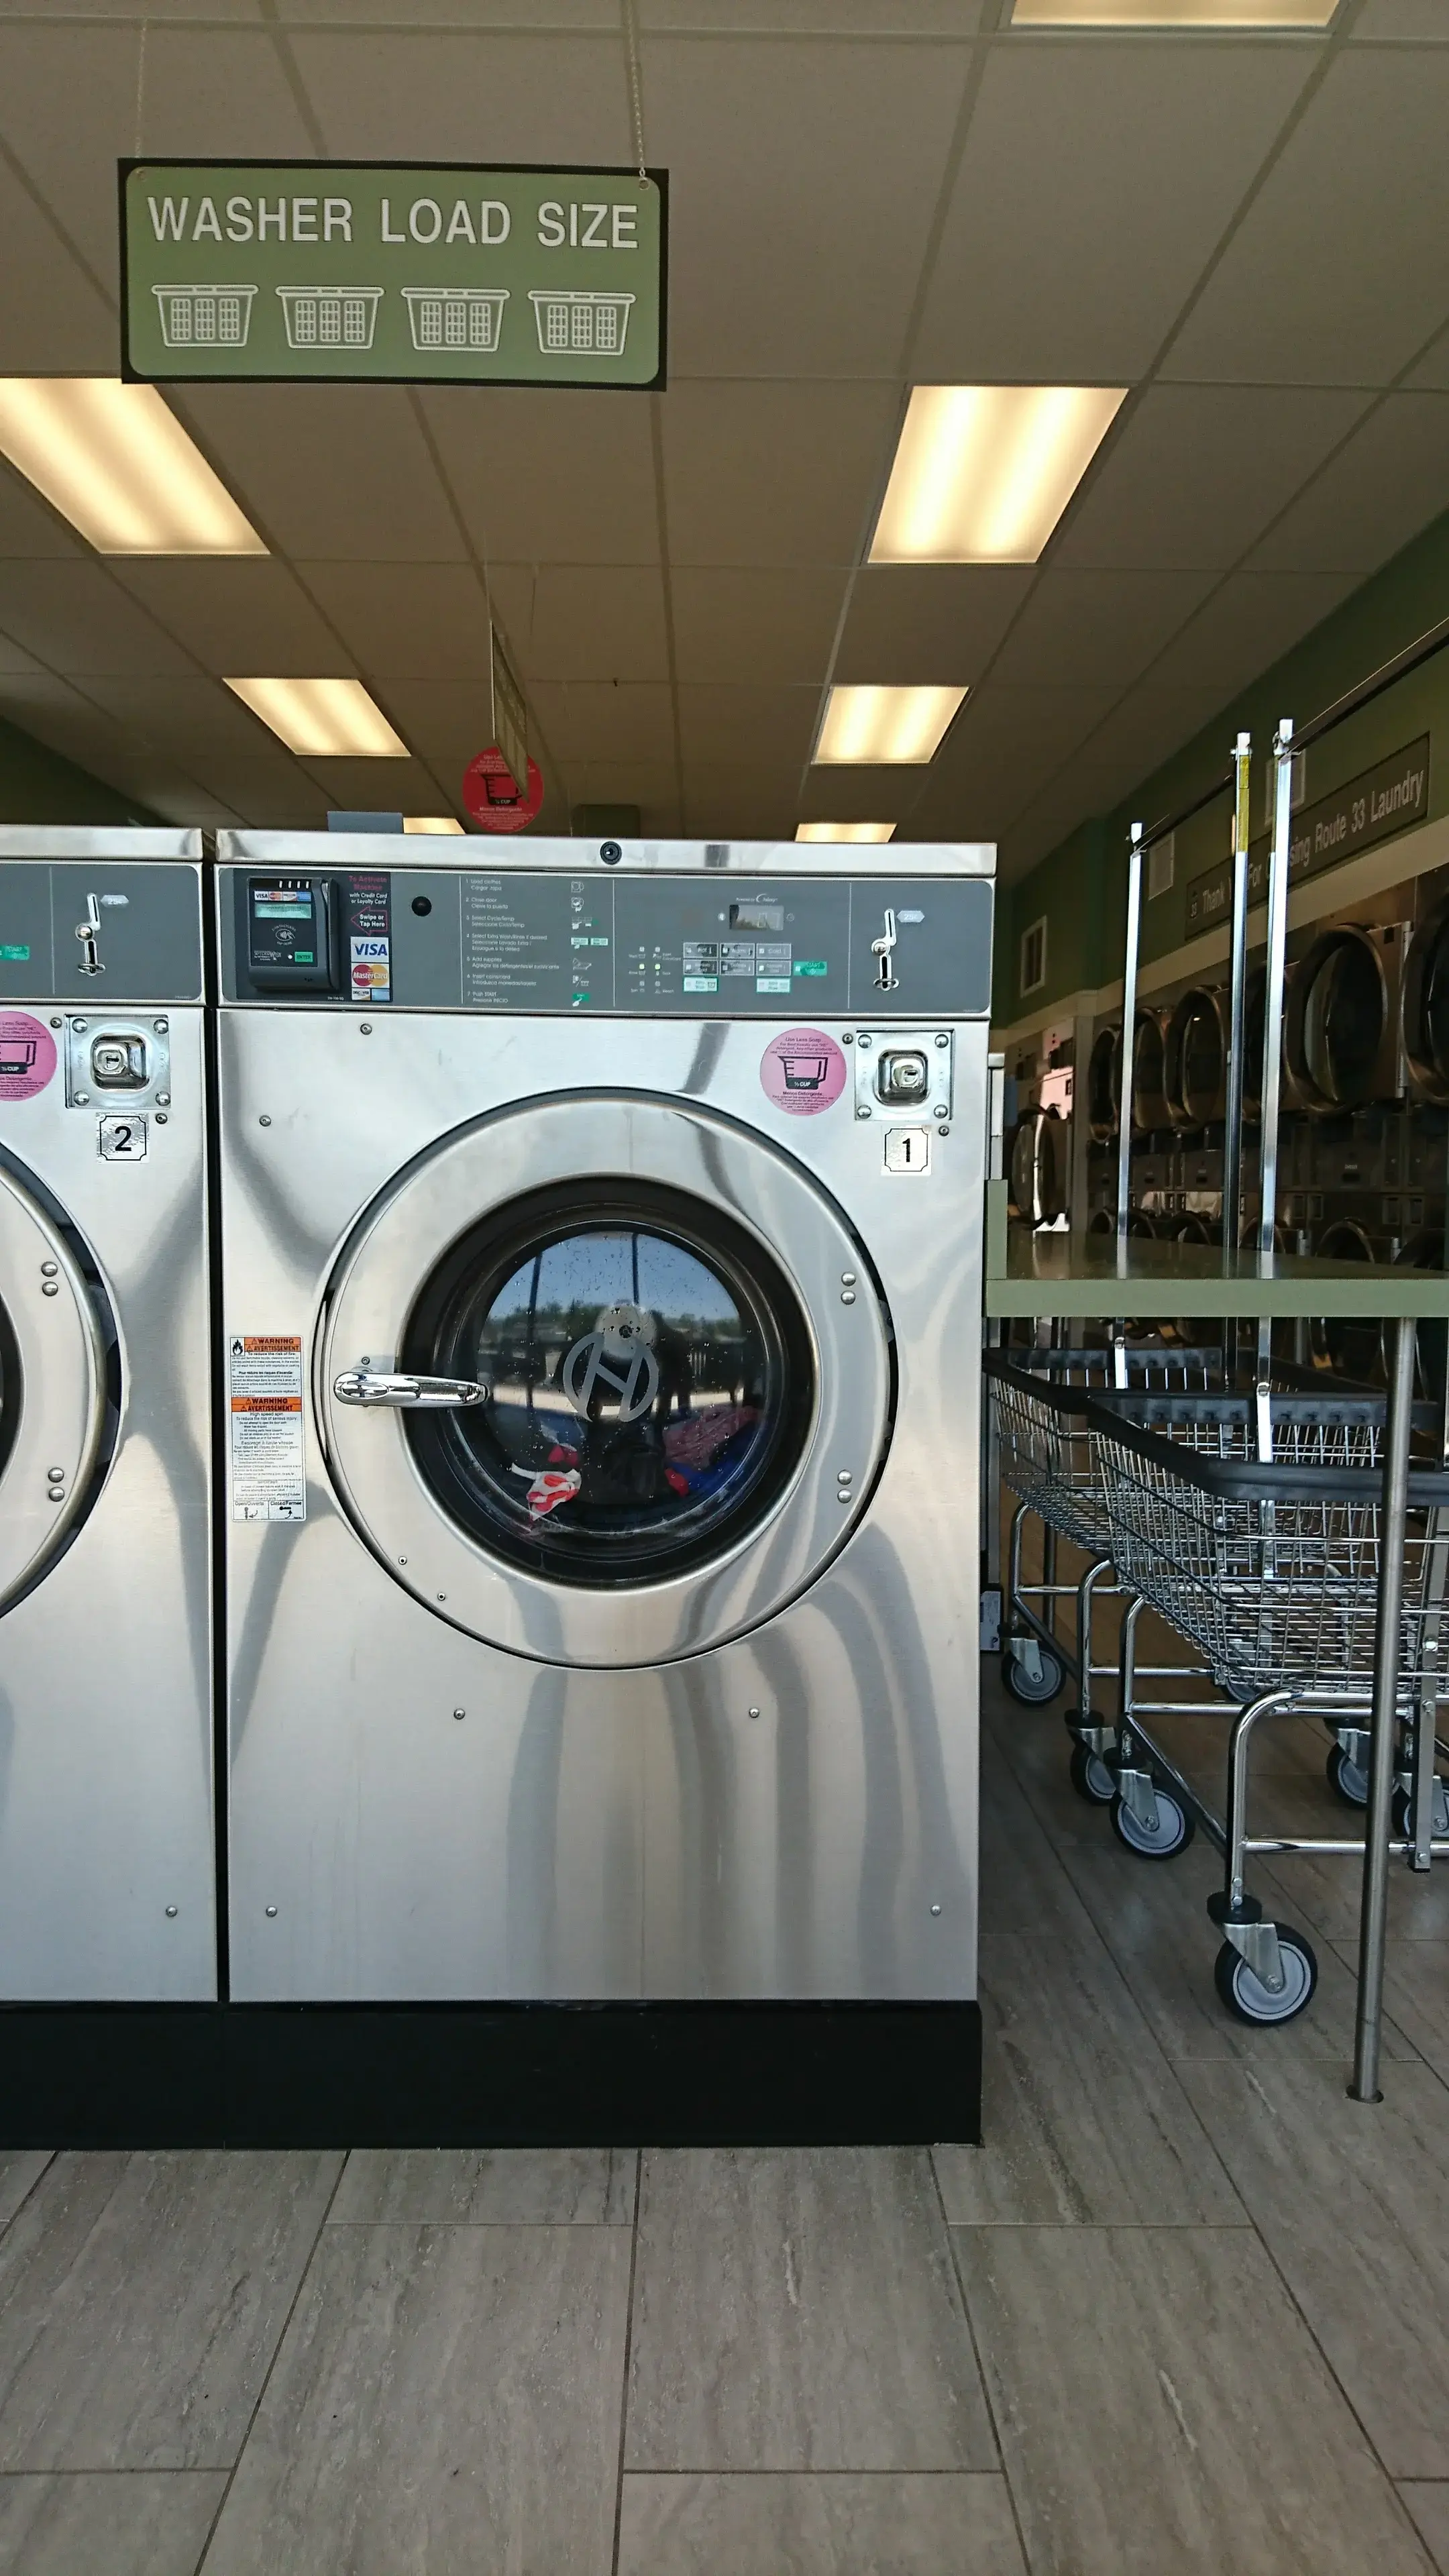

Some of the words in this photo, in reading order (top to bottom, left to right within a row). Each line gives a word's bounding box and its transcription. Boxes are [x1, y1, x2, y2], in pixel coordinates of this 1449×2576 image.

[146, 196, 354, 244] WASHER
[380, 199, 513, 246] LOAD
[537, 201, 639, 249] SIZE
[1202, 883, 1226, 914] Thank
[1314, 814, 1348, 853] Route
[1351, 798, 1366, 834] 33
[1371, 769, 1426, 822] Laundry
[354, 944, 388, 956] VISA
[115, 1126, 132, 1152] 2
[902, 1138, 911, 1163] 1
